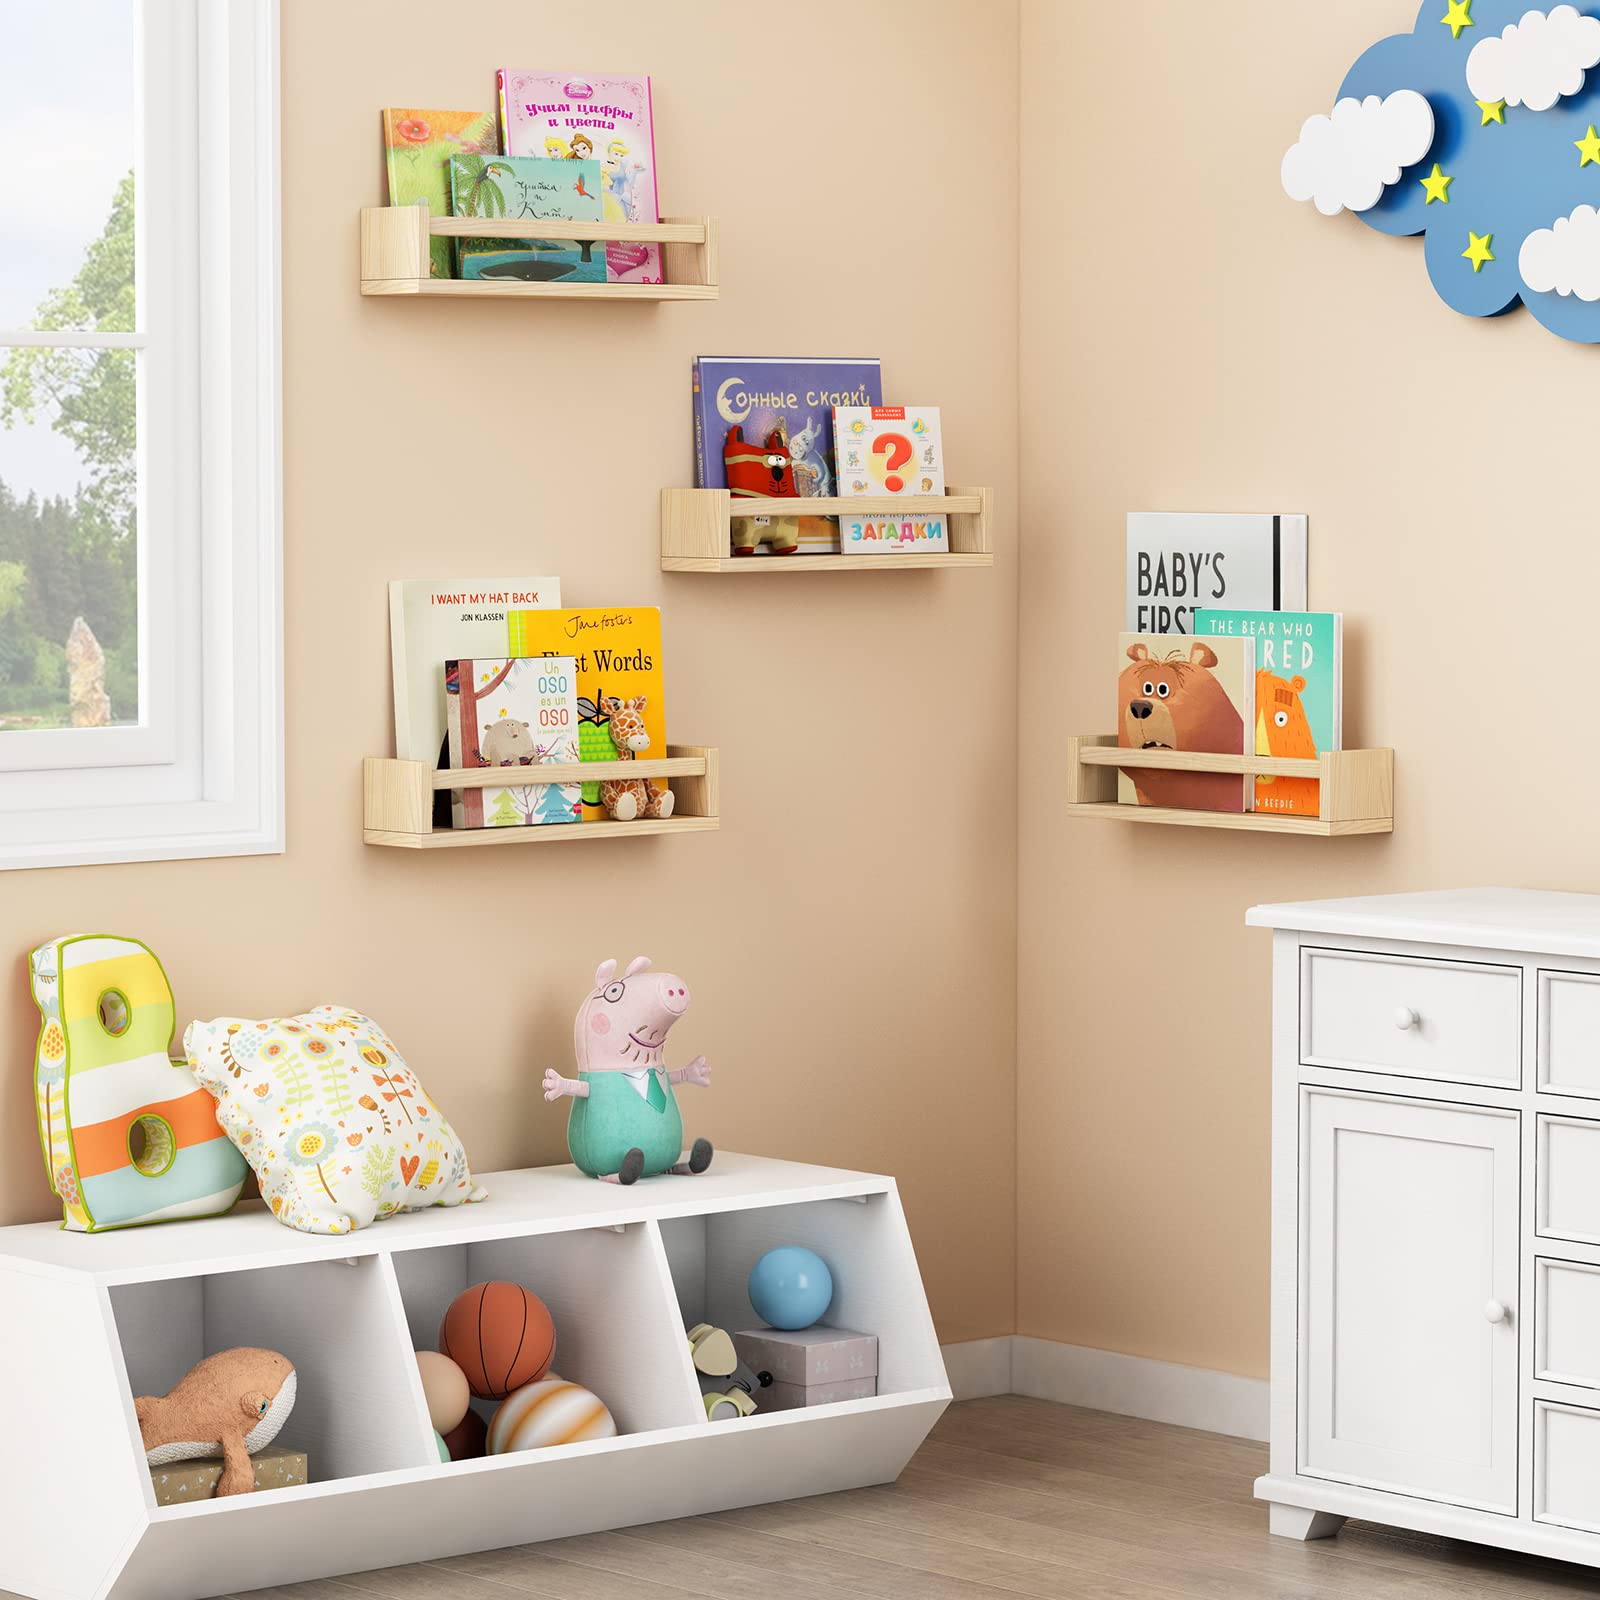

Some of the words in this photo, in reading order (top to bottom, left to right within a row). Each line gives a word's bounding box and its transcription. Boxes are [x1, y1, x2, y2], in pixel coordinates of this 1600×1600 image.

[525, 104, 570, 117] Учим
[577, 104, 633, 120] цифры
[548, 118, 559, 127] и
[565, 118, 615, 130] цвета
[851, 521, 942, 543] ЗАГАДКИ
[1137, 551, 1226, 599] BABY'S
[431, 594, 435, 605] I
[437, 594, 467, 605] WANT
[469, 593, 487, 604] MY
[489, 592, 509, 604] HAT
[512, 591, 539, 604] BACK
[460, 614, 473, 622] JON
[474, 613, 504, 622] KLASSEN
[1137, 605, 1202, 635] FIRS
[1210, 619, 1234, 634] THE
[1241, 620, 1275, 636] BEAR
[1282, 622, 1313, 636] WHO
[544, 661, 559, 675] Un
[593, 648, 653, 672] Words
[538, 675, 568, 694] OSO
[540, 697, 551, 706] es
[555, 696, 567, 705] un
[539, 708, 569, 727] OSO
[1264, 797, 1295, 809] BEEDIE
